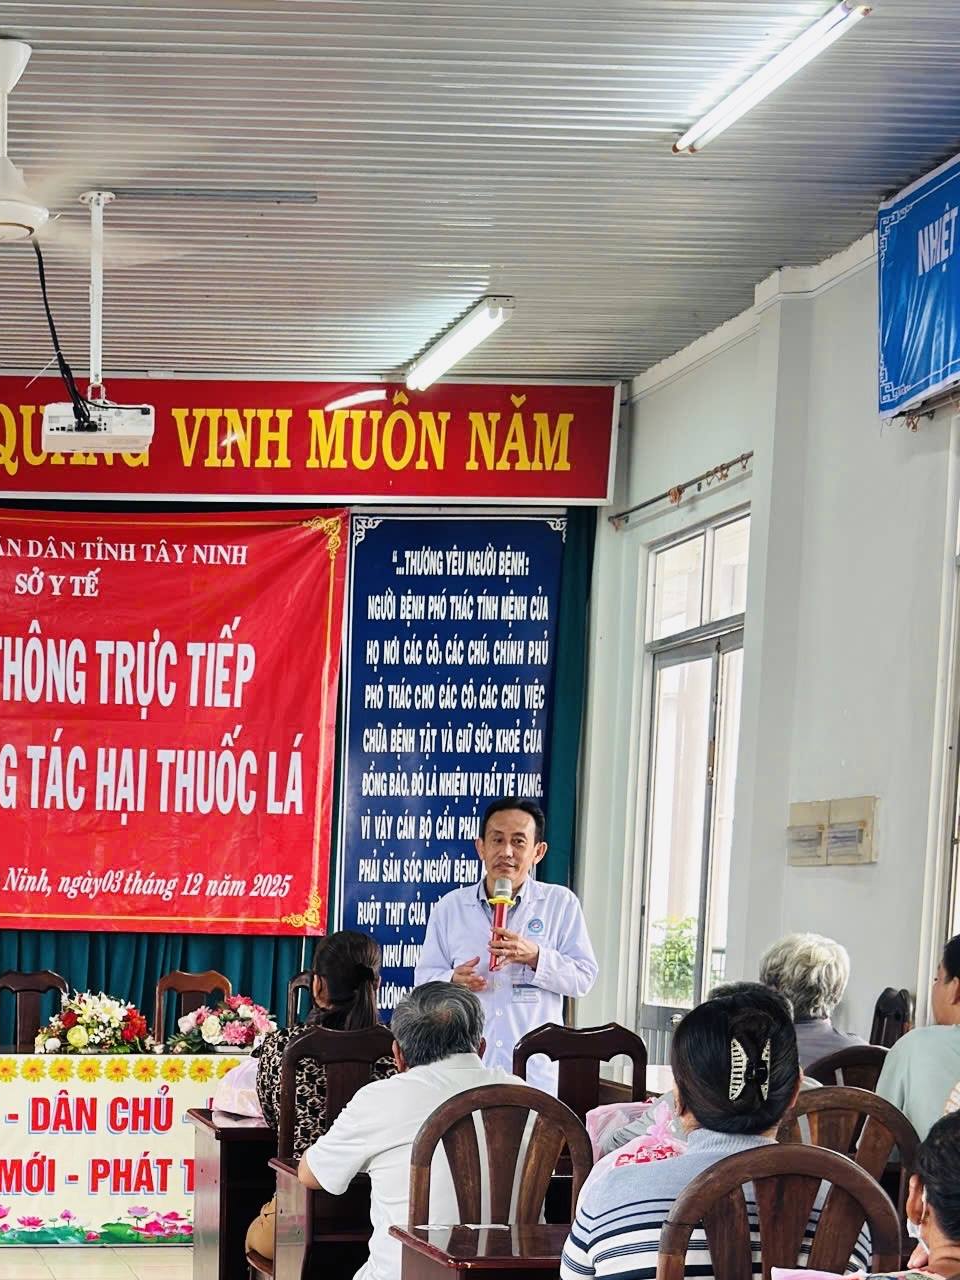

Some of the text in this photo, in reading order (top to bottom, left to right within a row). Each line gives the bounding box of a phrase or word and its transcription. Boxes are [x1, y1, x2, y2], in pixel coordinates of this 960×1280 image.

[918, 202, 959, 276] NHIỆT
[171, 408, 293, 469] VINH
[306, 390, 451, 471] MUÔN
[466, 393, 575, 471] NĂM
[28, 536, 77, 561] DÂN
[81, 537, 137, 562] TỈNH
[141, 539, 188, 564] TÂY
[192, 544, 249, 566] NINH
[446, 542, 496, 576] YÊU NGƯỜI
[15, 566, 102, 598] SỞ Y TẾ
[368, 586, 549, 628] NGƯỜI BỆNH PHÓ THÁC TÍNH MỆNH CỦA
[95, 627, 178, 720] TRỰC
[186, 615, 256, 708] TIẾP
[366, 640, 380, 672] HỌ
[383, 636, 400, 665] NƠI
[403, 634, 422, 665] CÁC
[445, 633, 464, 665] CÁC
[493, 632, 524, 666] CHÍNH
[527, 630, 549, 666] PHỦ
[364, 676, 384, 709] PHÓ
[388, 677, 412, 709] THÁC
[414, 684, 435, 709] CHO
[438, 677, 458, 710] CÁC
[479, 677, 498, 710] CÁC
[501, 676, 521, 710] CHÚ
[524, 678, 545, 717] VIỆC
[363, 722, 387, 753] CHỮA
[390, 722, 415, 760] BỆNH
[419, 722, 437, 760] TẬT
[441, 721, 453, 753] VÀ
[456, 723, 474, 753] GIỮ
[474, 722, 493, 754] SỨC
[523, 718, 543, 754] CỦA
[26, 727, 87, 812] TÁC
[95, 747, 147, 826] HẠI
[156, 725, 258, 815] THUỐC
[267, 732, 304, 816] LÁ
[411, 764, 424, 796] ĐÓ
[426, 764, 437, 797] LÀ
[439, 766, 468, 803] NHIỆM
[469, 772, 482, 804] VỤ
[483, 761, 502, 797] RẤT
[503, 763, 515, 797] VẺ
[360, 807, 480, 847] VÌ VẬY CÁN BỘ PHẢI
[2, 867, 52, 897] Ninh,
[125, 870, 178, 901] tháng
[180, 872, 201, 897] 12
[205, 873, 246, 897] năm
[249, 873, 293, 898] 2025
[359, 848, 380, 882] PHẢI
[383, 852, 401, 883] SĂN
[403, 851, 422, 883] SÓC
[423, 851, 451, 883] NGƯỜI
[454, 853, 478, 887] BỆNH
[357, 894, 381, 933] RUỘT
[385, 902, 406, 933] THỊT
[408, 891, 426, 925] CỦA
[382, 940, 403, 968] NHƯ
[28, 1089, 99, 1135] DÂN
[109, 1084, 175, 1135] CHỦ
[89, 1149, 174, 1195] PHÁT
